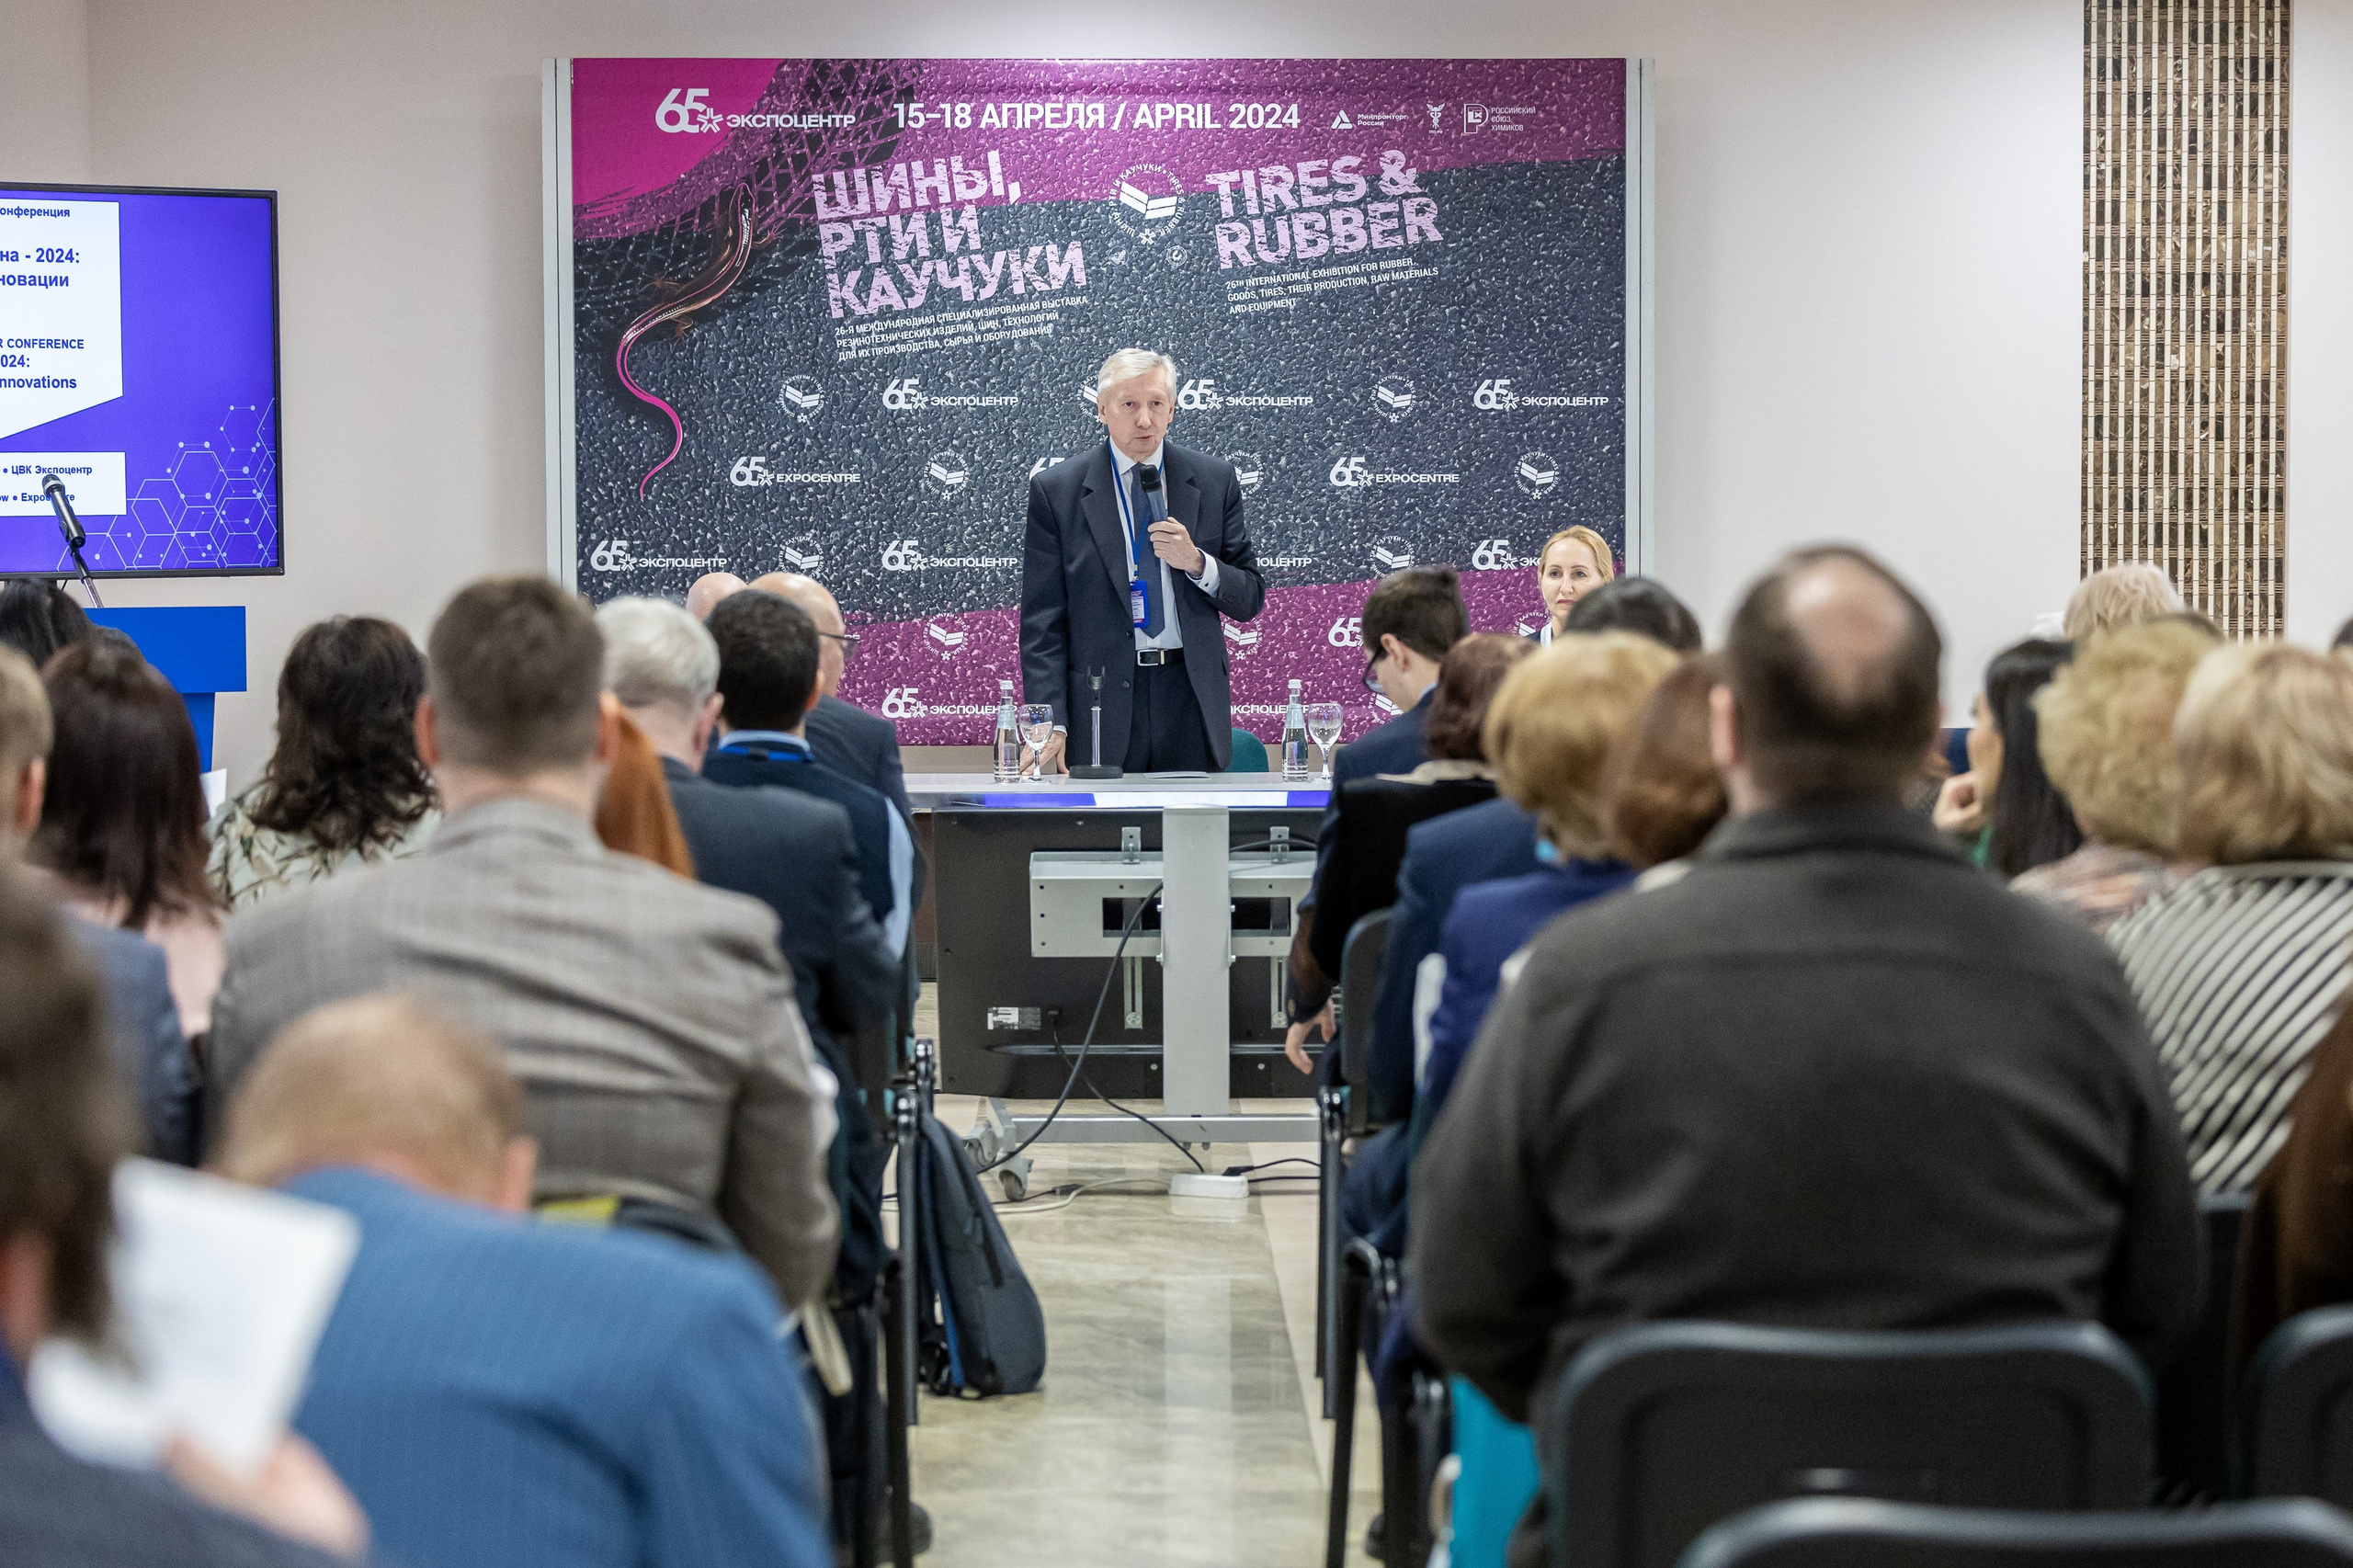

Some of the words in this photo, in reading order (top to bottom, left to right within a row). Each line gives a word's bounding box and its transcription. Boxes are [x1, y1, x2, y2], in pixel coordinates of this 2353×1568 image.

[726, 114, 856, 130] ЭКСПОЦЕНТР
[980, 103, 1105, 129] АПРЕЛЯ
[1112, 103, 1127, 131] /
[1133, 103, 1221, 129] APRIL
[1229, 103, 1301, 129] 2024
[812, 150, 1021, 220] ШИНЫ,
[1119, 164, 1162, 181] КАУЧУКИ
[1166, 172, 1184, 195] TIRES
[1205, 155, 1367, 219] TIRES
[1380, 149, 1423, 196] &
[819, 211, 930, 269] РТИ
[940, 205, 981, 253] И
[1215, 197, 1444, 269] RUBBER
[36, 247, 80, 263] 2024:
[826, 241, 1087, 319] КАУЧУКИ
[1245, 271, 1312, 287] INTERNATIONAL
[1313, 265, 1359, 278] EXHIBITION
[1361, 262, 1378, 272] FOR
[1380, 257, 1414, 269] RUBBER
[1227, 290, 1258, 302] GOODS,
[1260, 287, 1286, 298] TIRES,
[1288, 283, 1313, 294] THEIR
[1313, 277, 1370, 291] PRODUCTION,
[1371, 273, 1390, 284] RAW
[1392, 267, 1439, 280] MATERIALS
[835, 325, 854, 336] 26-Я
[856, 315, 936, 333] МЕЖДУНАРОДНАЯ
[937, 301, 1040, 323] СПЕЦИАЛИЗИРОВАННАЯ
[1041, 295, 1088, 309] ВЫСТАВКА
[1229, 304, 1246, 314] AND
[1248, 298, 1297, 312] EQUIPMENT
[836, 328, 931, 347] РЕЗИНОТЕХНИЧЕСКИХ
[933, 321, 976, 335] ИЗДЕЛИЙ,
[978, 320, 1001, 331] ШИН,
[1003, 310, 1059, 326] ТЕХНОЛОГИЙ
[7, 338, 85, 349] CONFERENCE
[839, 351, 857, 362] ДЛЯ
[871, 339, 942, 357] ПРОИЗВОДСТВА,
[944, 335, 973, 347] СЫРЬЯ
[974, 334, 982, 343] И
[983, 325, 1052, 342] ОБОРУДОВАНИЯ
[930, 396, 1018, 406] ЭКСПОЦЕНТР
[1225, 396, 1313, 406] ЭКСПОЦЕНТР
[1521, 396, 1608, 406] ЭКСПОЦЕНТР
[11, 465, 32, 475] ЦВК
[35, 466, 93, 475] Экспоцентр
[777, 473, 860, 483] EXPOCENTRE
[1376, 473, 1460, 483] EXPOCENTRE
[639, 558, 727, 567] ЭКСПОЦЕНТР
[930, 557, 1017, 567] ЭКСПОЦЕНТР
